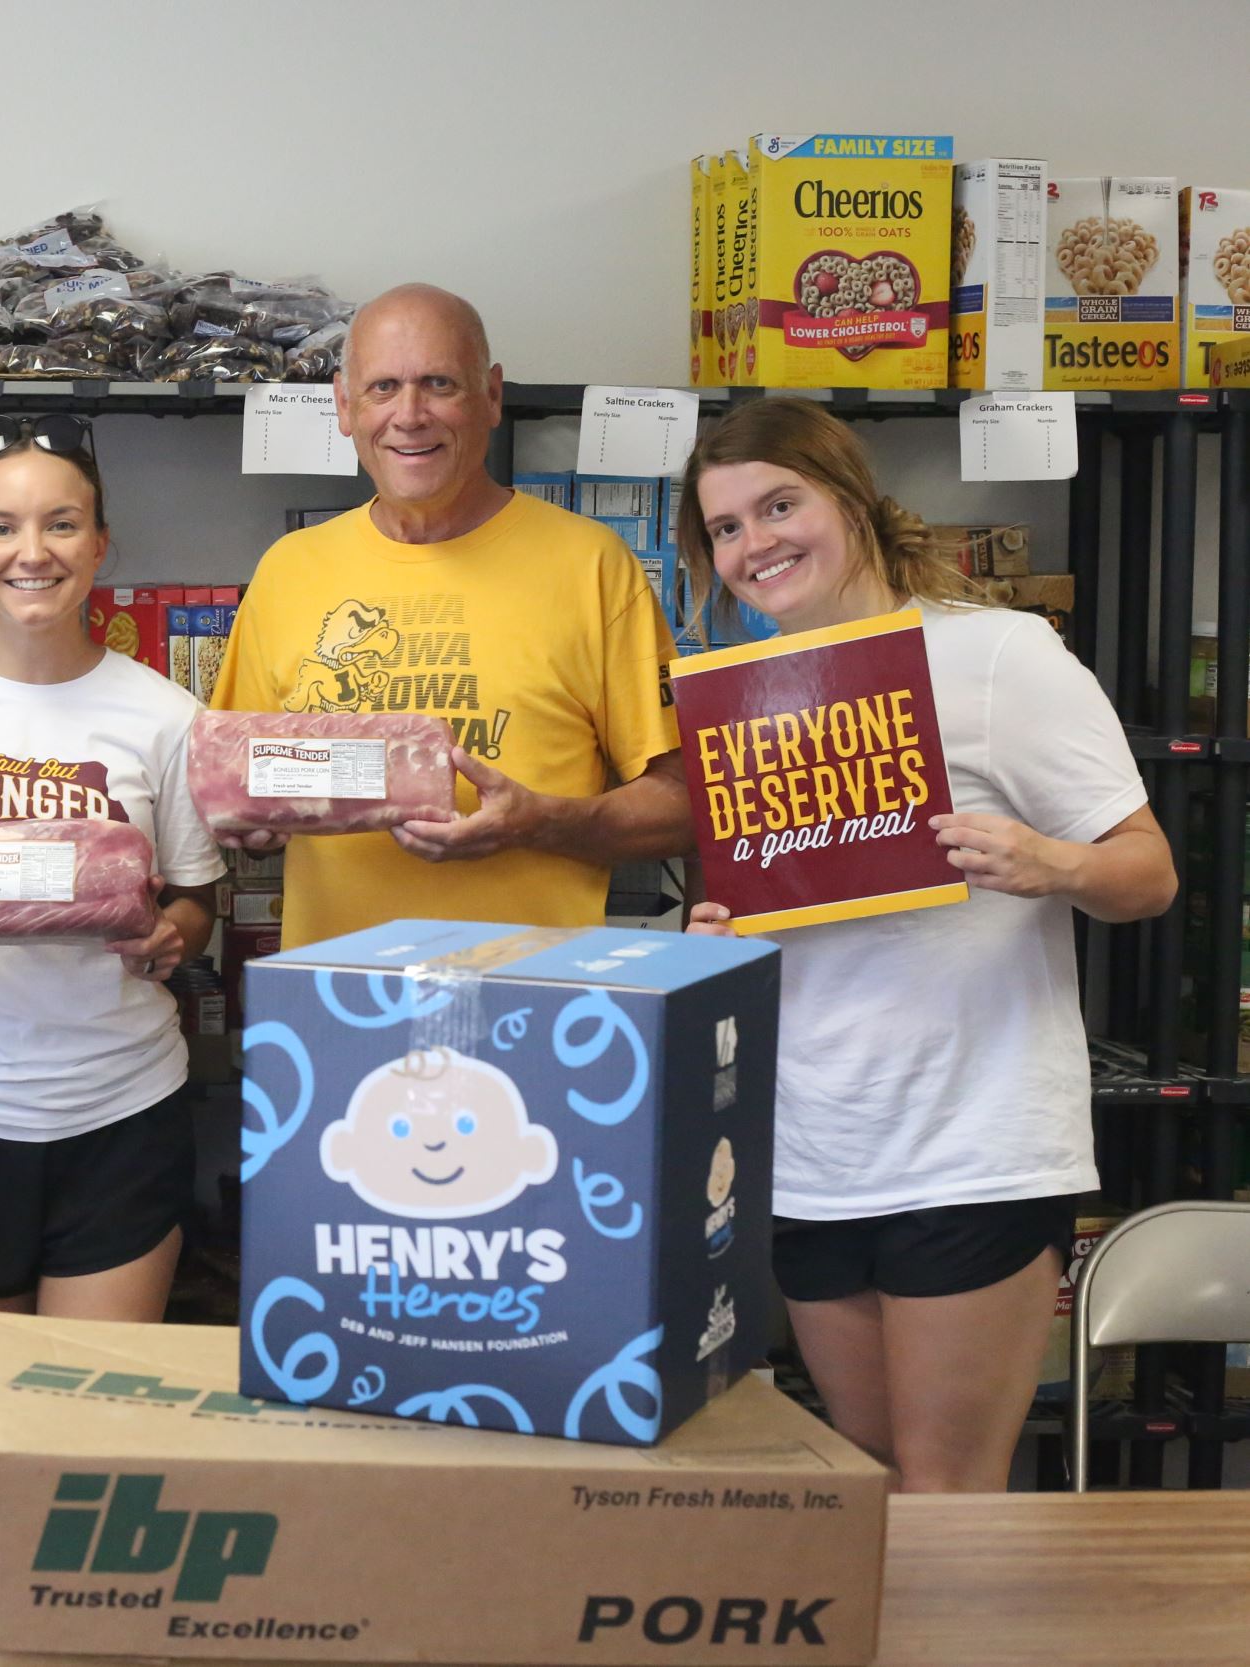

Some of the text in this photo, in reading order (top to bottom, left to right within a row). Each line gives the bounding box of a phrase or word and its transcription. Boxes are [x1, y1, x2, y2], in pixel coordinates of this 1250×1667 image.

[814, 138, 887, 156] FAMILY
[892, 139, 935, 156] SIZE
[794, 179, 923, 219] Cheerios
[818, 226, 911, 238] 100% OATS
[716, 203, 726, 302] Cheerios
[834, 315, 879, 327] CAN HELP
[1080, 306, 1118, 314] GRAIN
[1080, 313, 1118, 321] CEREAL
[790, 322, 906, 339] LOWER CHOLESTEROL
[1044, 333, 1169, 368] Tasteeos
[269, 394, 288, 403] Mac
[301, 395, 333, 404] Cheese
[605, 396, 675, 409] Saltine Crackers
[979, 403, 1053, 412] Graham Crackers
[696, 688, 919, 784] EVERYONE
[254, 744, 330, 762] SUPREME TENDER
[37, 757, 81, 780] Out
[705, 748, 929, 841] DESERVES
[733, 799, 916, 869] a good meal
[314, 1223, 568, 1283] HENRY'S
[359, 1261, 545, 1333] Heroes
[340, 1317, 568, 1352] DEB AND JEFF HANSEN FOUNDATION
[571, 1485, 844, 1511] Tyson Fresh Meats, Inc.
[31, 1472, 279, 1604] ibp
[29, 1584, 163, 1610] Trusted
[166, 1616, 360, 1642] Excellence
[576, 1595, 836, 1646] PORK
